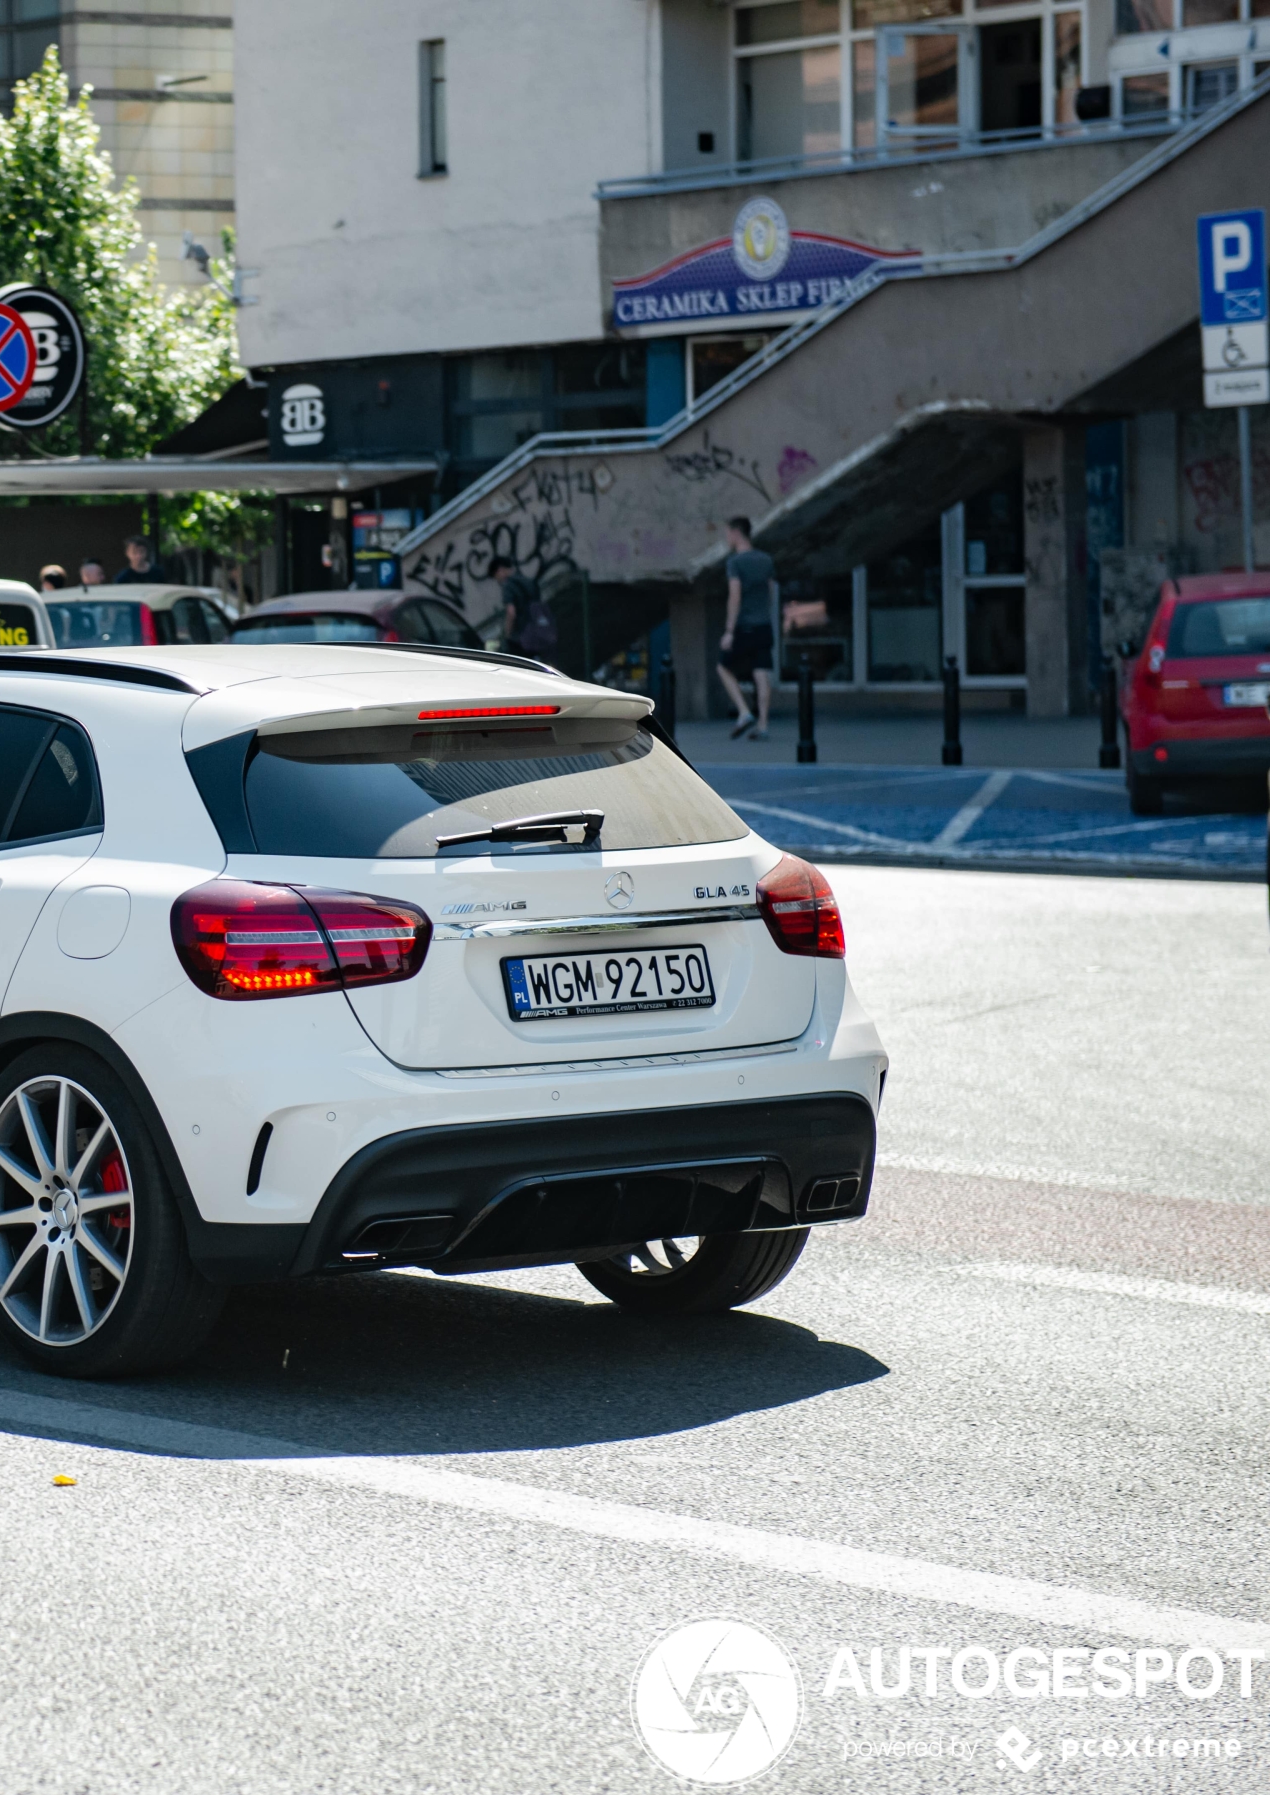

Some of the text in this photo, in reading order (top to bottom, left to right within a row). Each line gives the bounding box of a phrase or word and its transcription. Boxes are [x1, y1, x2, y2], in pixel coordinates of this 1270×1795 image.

[1212, 221, 1251, 293] P
[616, 290, 729, 322] CERAMIKA
[736, 281, 805, 311] SKLEP
[694, 884, 750, 899] GLA 45
[468, 900, 527, 914] AMG
[528, 953, 706, 1006] WGM 92150
[514, 992, 528, 1004] PL
[534, 1007, 569, 1017] AMG
[576, 1005, 616, 1015] Performance
[616, 1003, 637, 1012] Center
[637, 1001, 668, 1010] Warszawa
[677, 999, 686, 1007] 22
[687, 998, 697, 1006] 312
